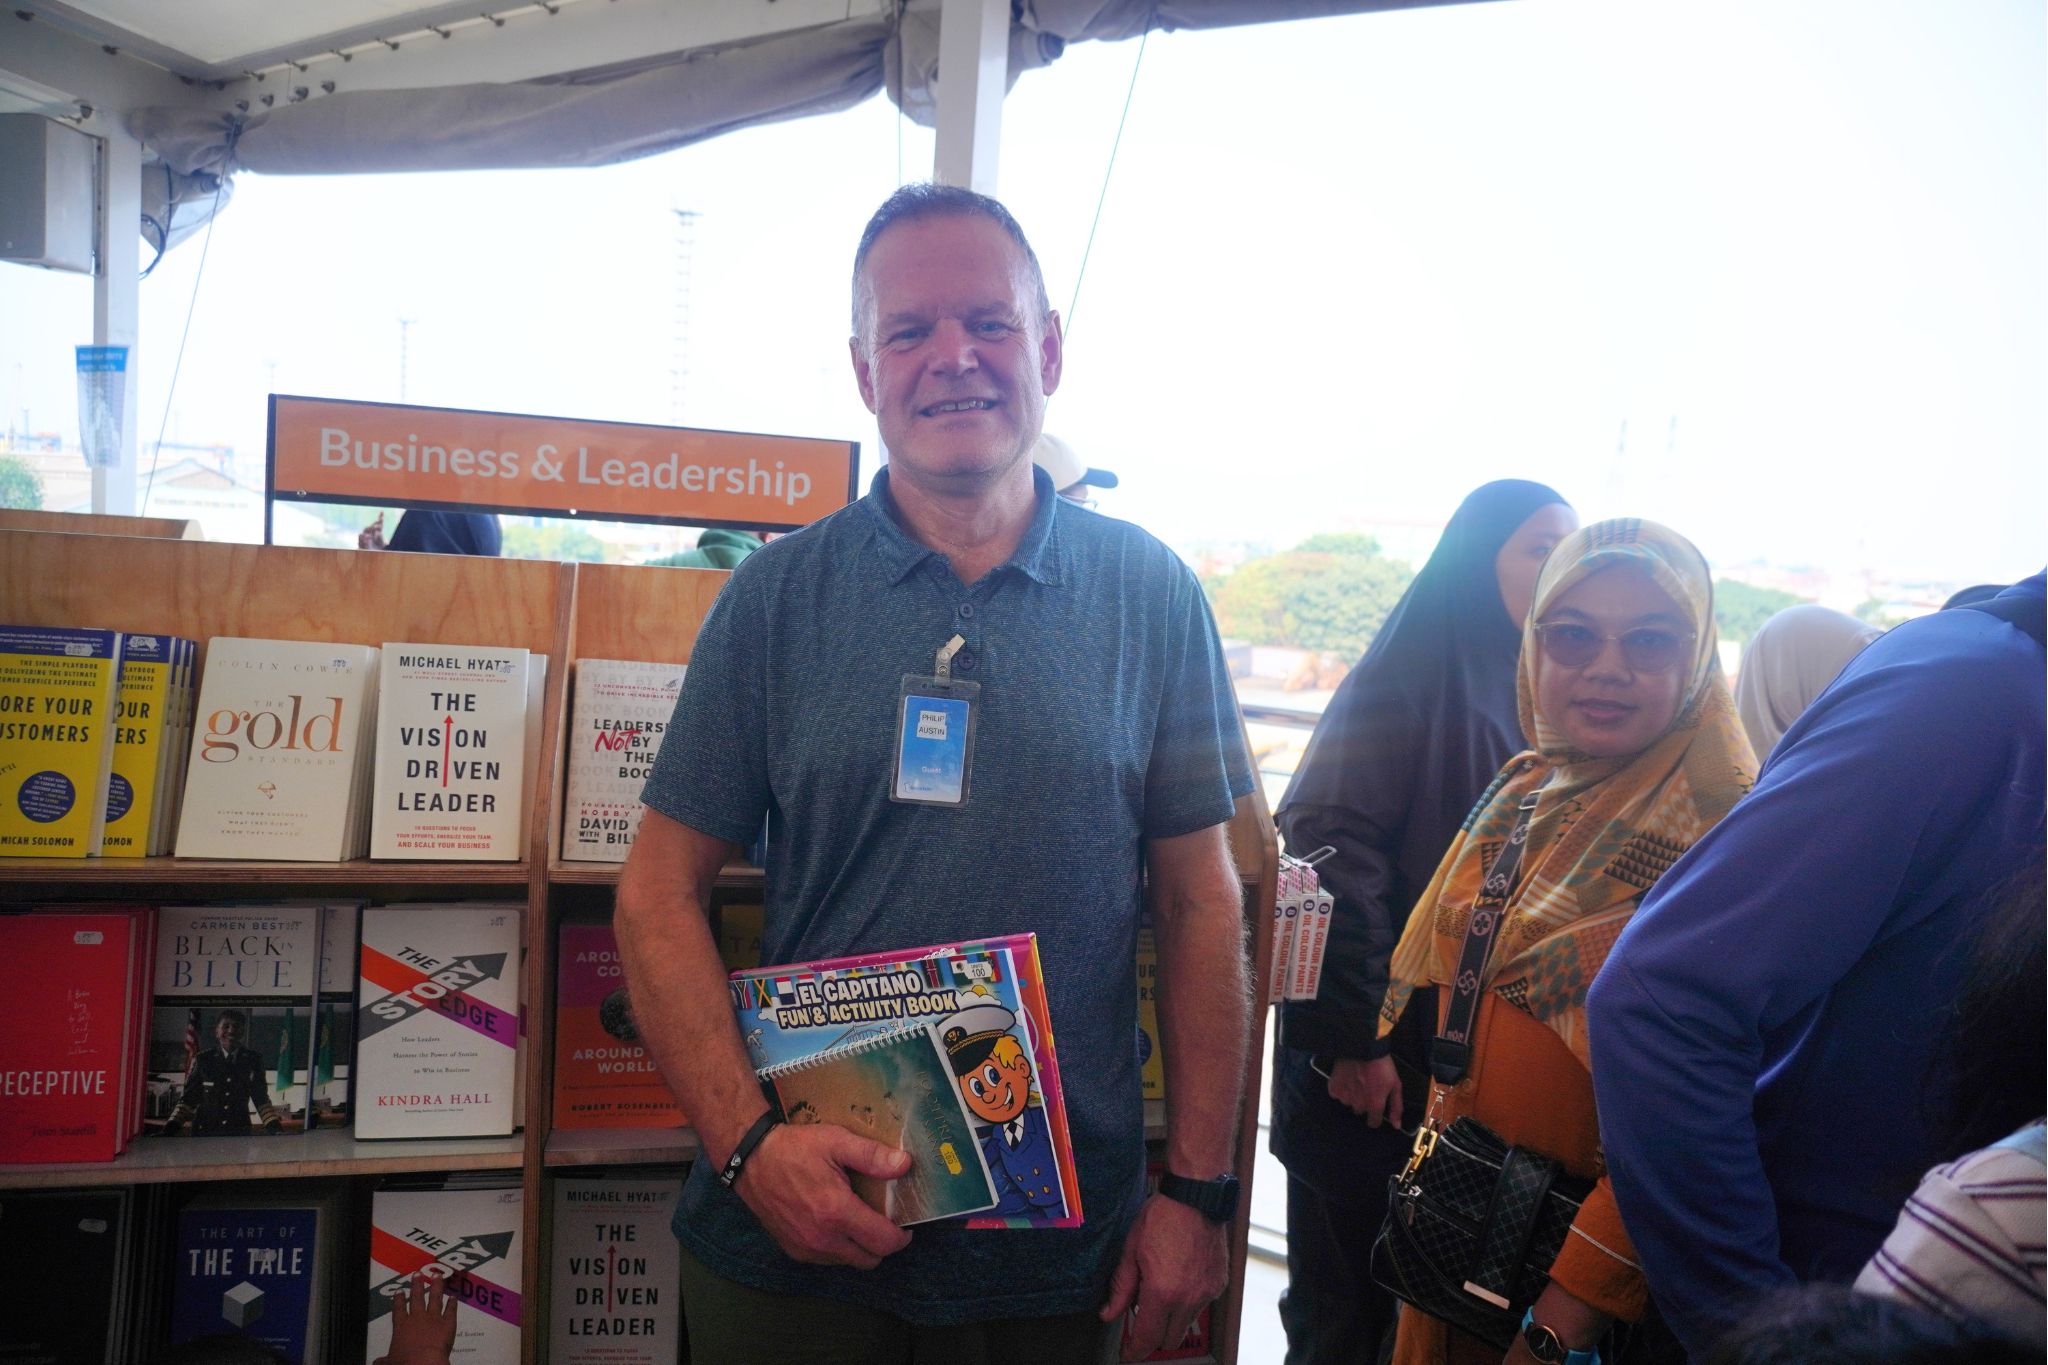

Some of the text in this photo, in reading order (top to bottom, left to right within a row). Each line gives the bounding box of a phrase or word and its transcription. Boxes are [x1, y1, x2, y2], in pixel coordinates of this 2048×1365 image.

[320, 428, 811, 504] Business & Leadership
[400, 656, 462, 669] MICHAEL
[45, 697, 92, 715] YOUR
[254, 700, 285, 708] THE
[430, 692, 476, 712] THE
[922, 714, 944, 722] PHILIP
[201, 695, 344, 764] gold
[919, 726, 944, 735] AUSTIN
[632, 736, 651, 748] BY
[624, 751, 655, 764] THE
[398, 792, 496, 812] LEADER
[580, 818, 628, 830] DAVID
[1, 836, 74, 846] MICAH SOLOMON
[579, 830, 600, 838] WITH
[190, 922, 246, 930] CARMEN
[252, 922, 284, 930] BEST
[1285, 921, 1294, 932] OIL
[1302, 914, 1312, 927] OIL
[1317, 918, 1327, 928] OIL
[174, 935, 294, 956] BLACK IN
[1279, 935, 1291, 966] COLOUR
[1299, 930, 1310, 962] COLOUR
[1311, 932, 1324, 964] COLOUR
[398, 946, 440, 970] THE
[172, 960, 293, 988] BLUE
[1274, 968, 1286, 996] PAINTS
[1296, 965, 1306, 994] PAINTS
[1306, 966, 1318, 994] PAINTS
[371, 959, 486, 1020] STORY
[798, 972, 922, 1005] EL CAPITANO
[440, 992, 498, 1034] EDGE
[778, 992, 957, 1028] FUN & ACTIVITY BOOK
[573, 1048, 644, 1060] AROUND
[598, 1061, 658, 1073] WORLD
[378, 1094, 492, 1106] KINDRA HALL
[568, 1191, 661, 1202] MICHAEL HYAT
[200, 1227, 296, 1238] THE ART OF
[406, 1227, 448, 1251] THE
[596, 1224, 636, 1242] THE
[190, 1248, 302, 1276] THE TALE
[569, 1318, 656, 1336] LEADER
